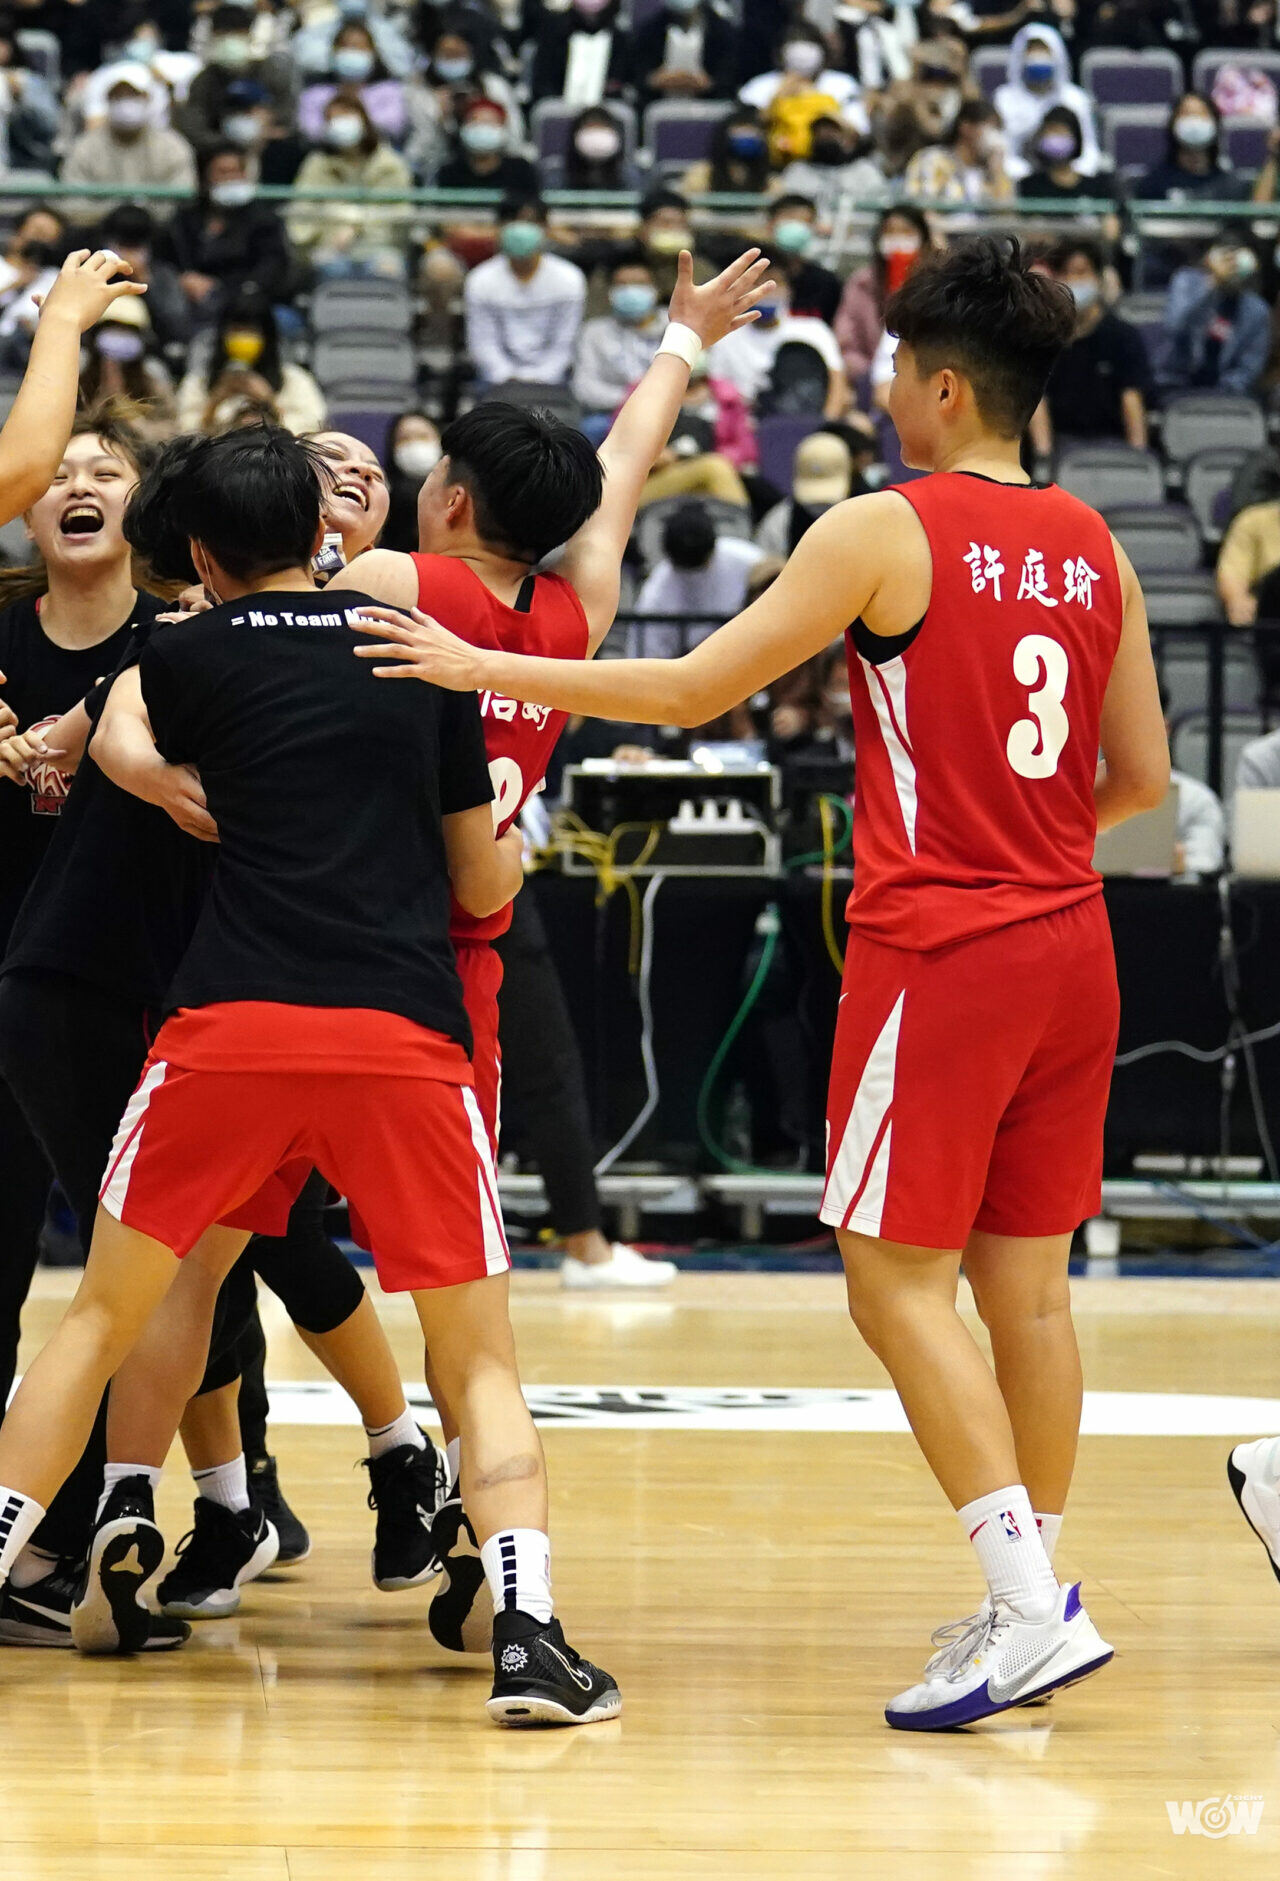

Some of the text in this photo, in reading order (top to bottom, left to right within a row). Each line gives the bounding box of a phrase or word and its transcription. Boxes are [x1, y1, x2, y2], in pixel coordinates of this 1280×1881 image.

[963, 541, 1101, 611] 許庭瑜
[248, 611, 278, 627] No
[280, 612, 342, 627] Team
[1006, 634, 1069, 779] 3
